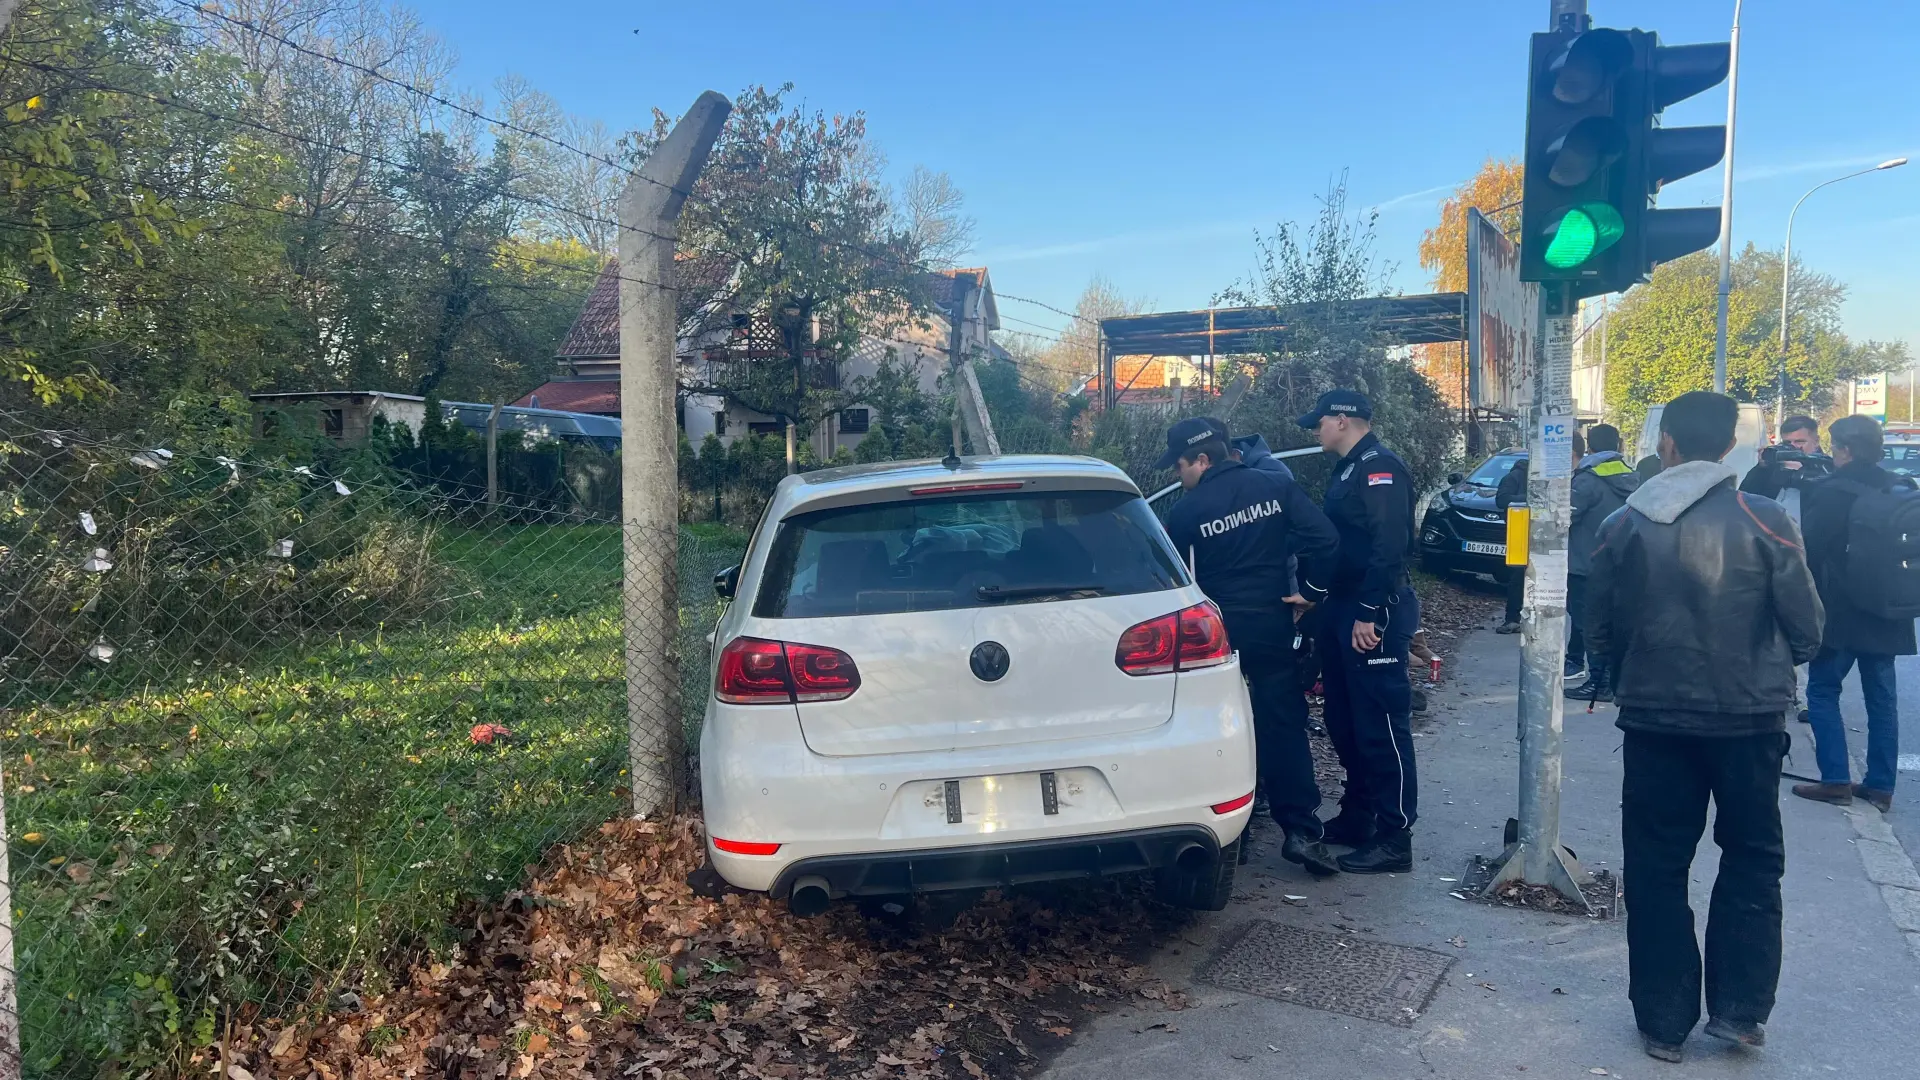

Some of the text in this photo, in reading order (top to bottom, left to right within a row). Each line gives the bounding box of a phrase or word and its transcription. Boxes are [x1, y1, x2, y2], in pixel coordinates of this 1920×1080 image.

[1544, 424, 1565, 436] PC
[1199, 499, 1282, 538] ПОЛИЦИЈА
[1467, 543, 1476, 551] BG
[1368, 657, 1398, 665] ПОЛИЦИЈА
